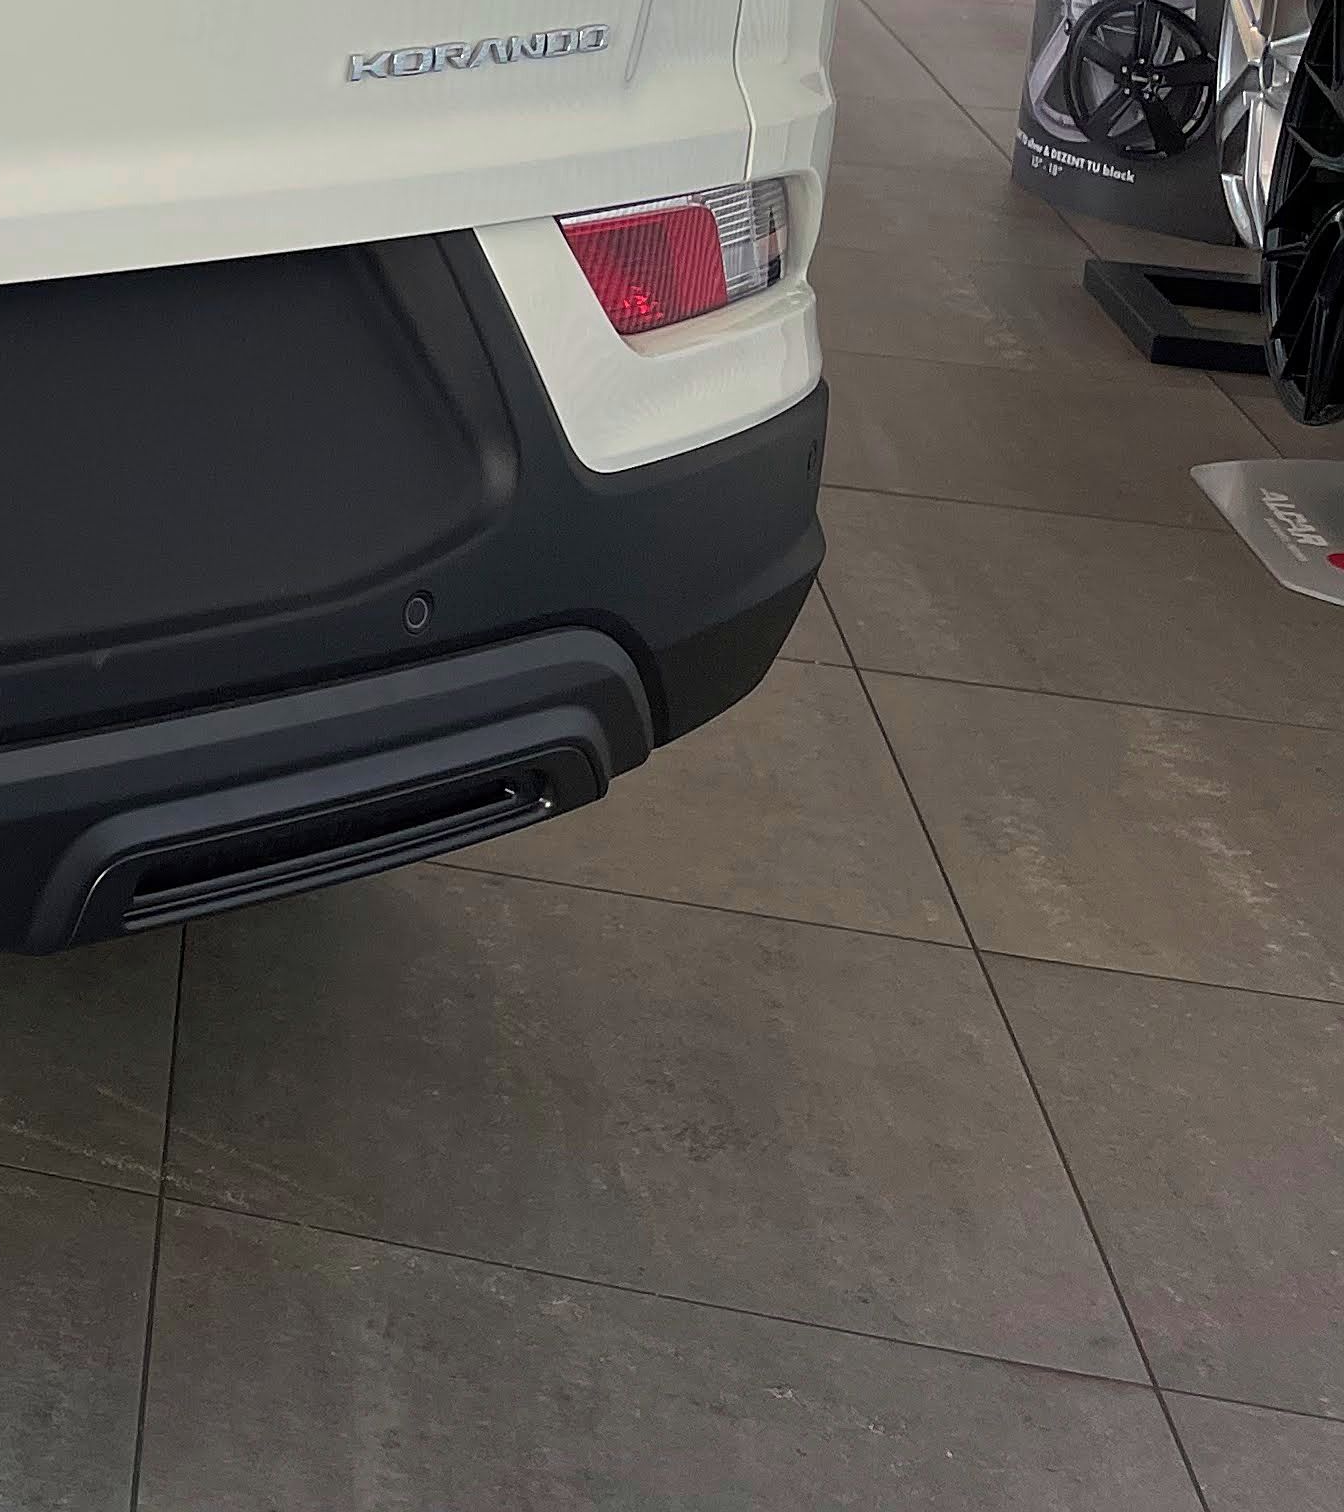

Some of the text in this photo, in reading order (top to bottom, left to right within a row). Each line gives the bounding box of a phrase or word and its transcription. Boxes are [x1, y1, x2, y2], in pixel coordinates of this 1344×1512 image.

[347, 23, 610, 82] KORANDO
[1087, 160, 1101, 173] TU
[1103, 164, 1135, 184] black
